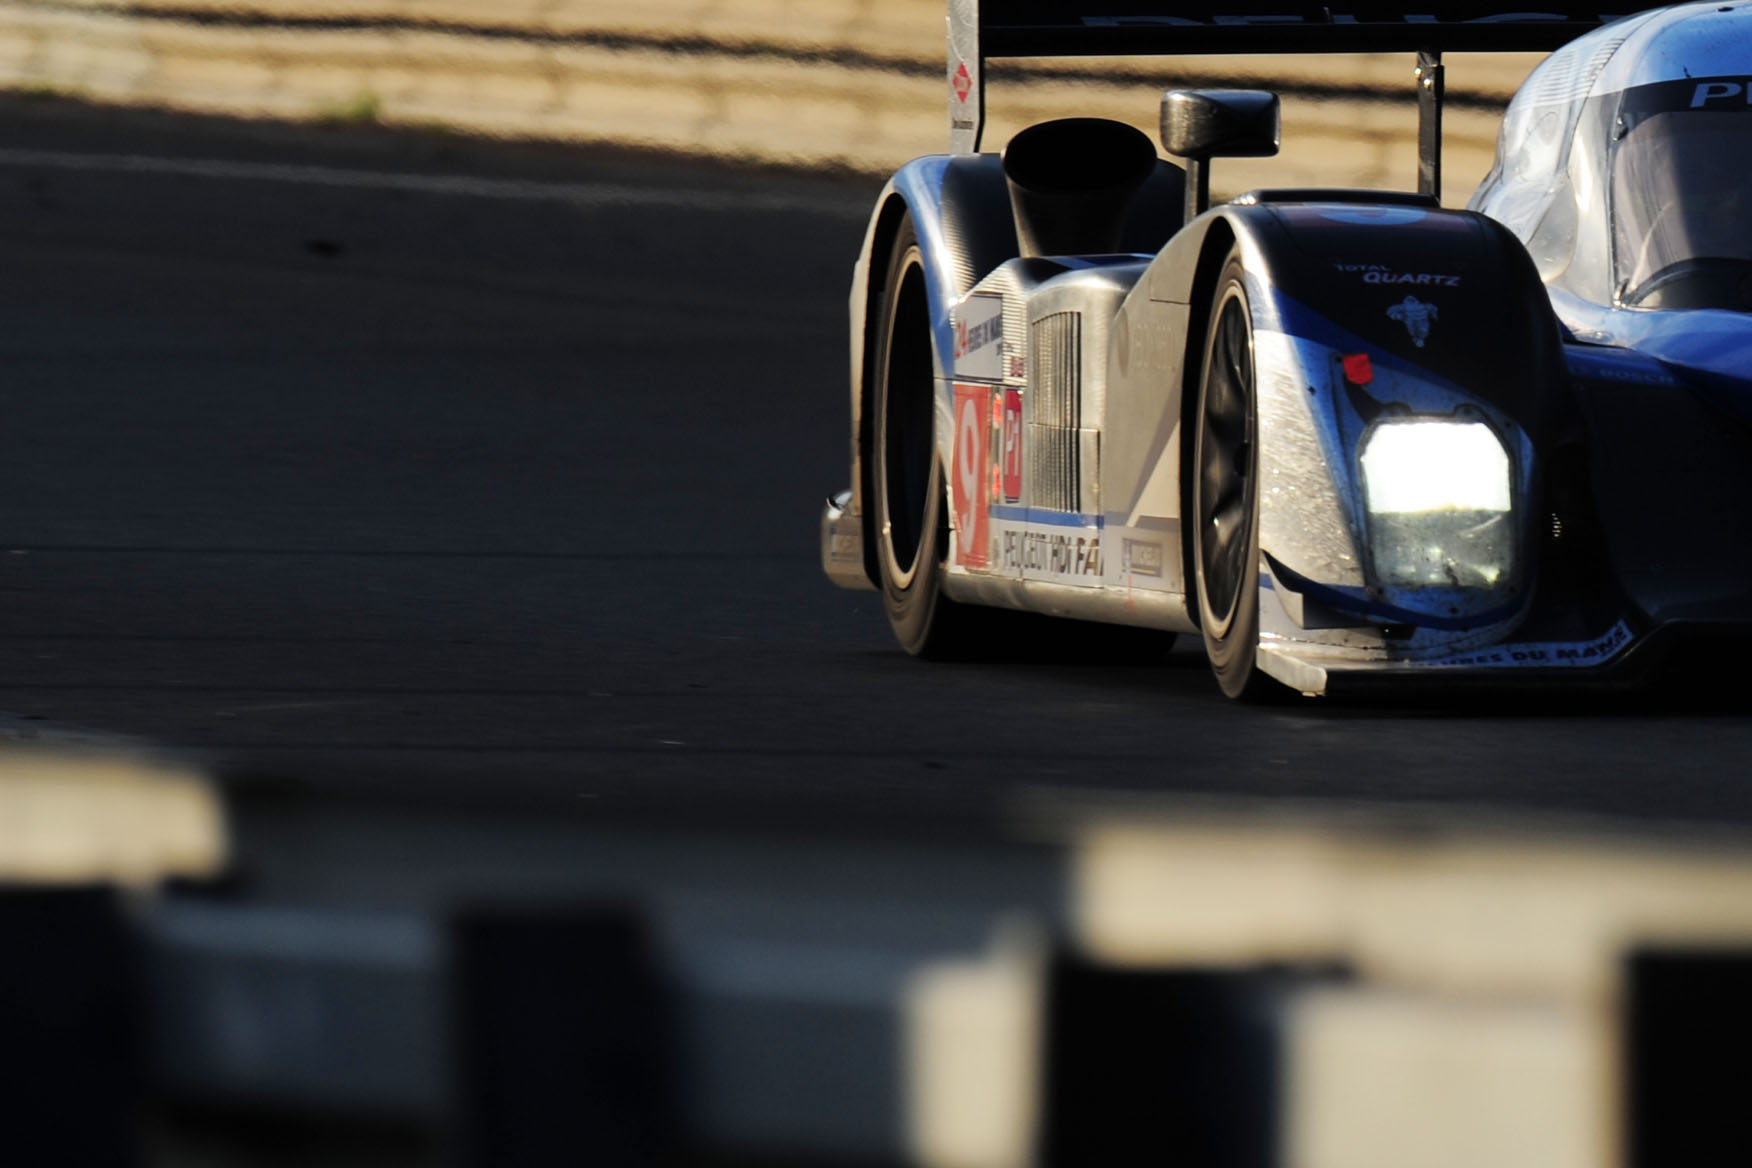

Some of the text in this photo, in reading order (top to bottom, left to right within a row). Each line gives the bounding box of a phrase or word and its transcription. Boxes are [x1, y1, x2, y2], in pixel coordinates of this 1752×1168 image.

[1335, 263, 1393, 272] TOTAL
[1362, 271, 1461, 287] QUARTZ
[1004, 408, 1020, 476] P1
[959, 398, 980, 554] 9
[1511, 650, 1546, 662] DU
